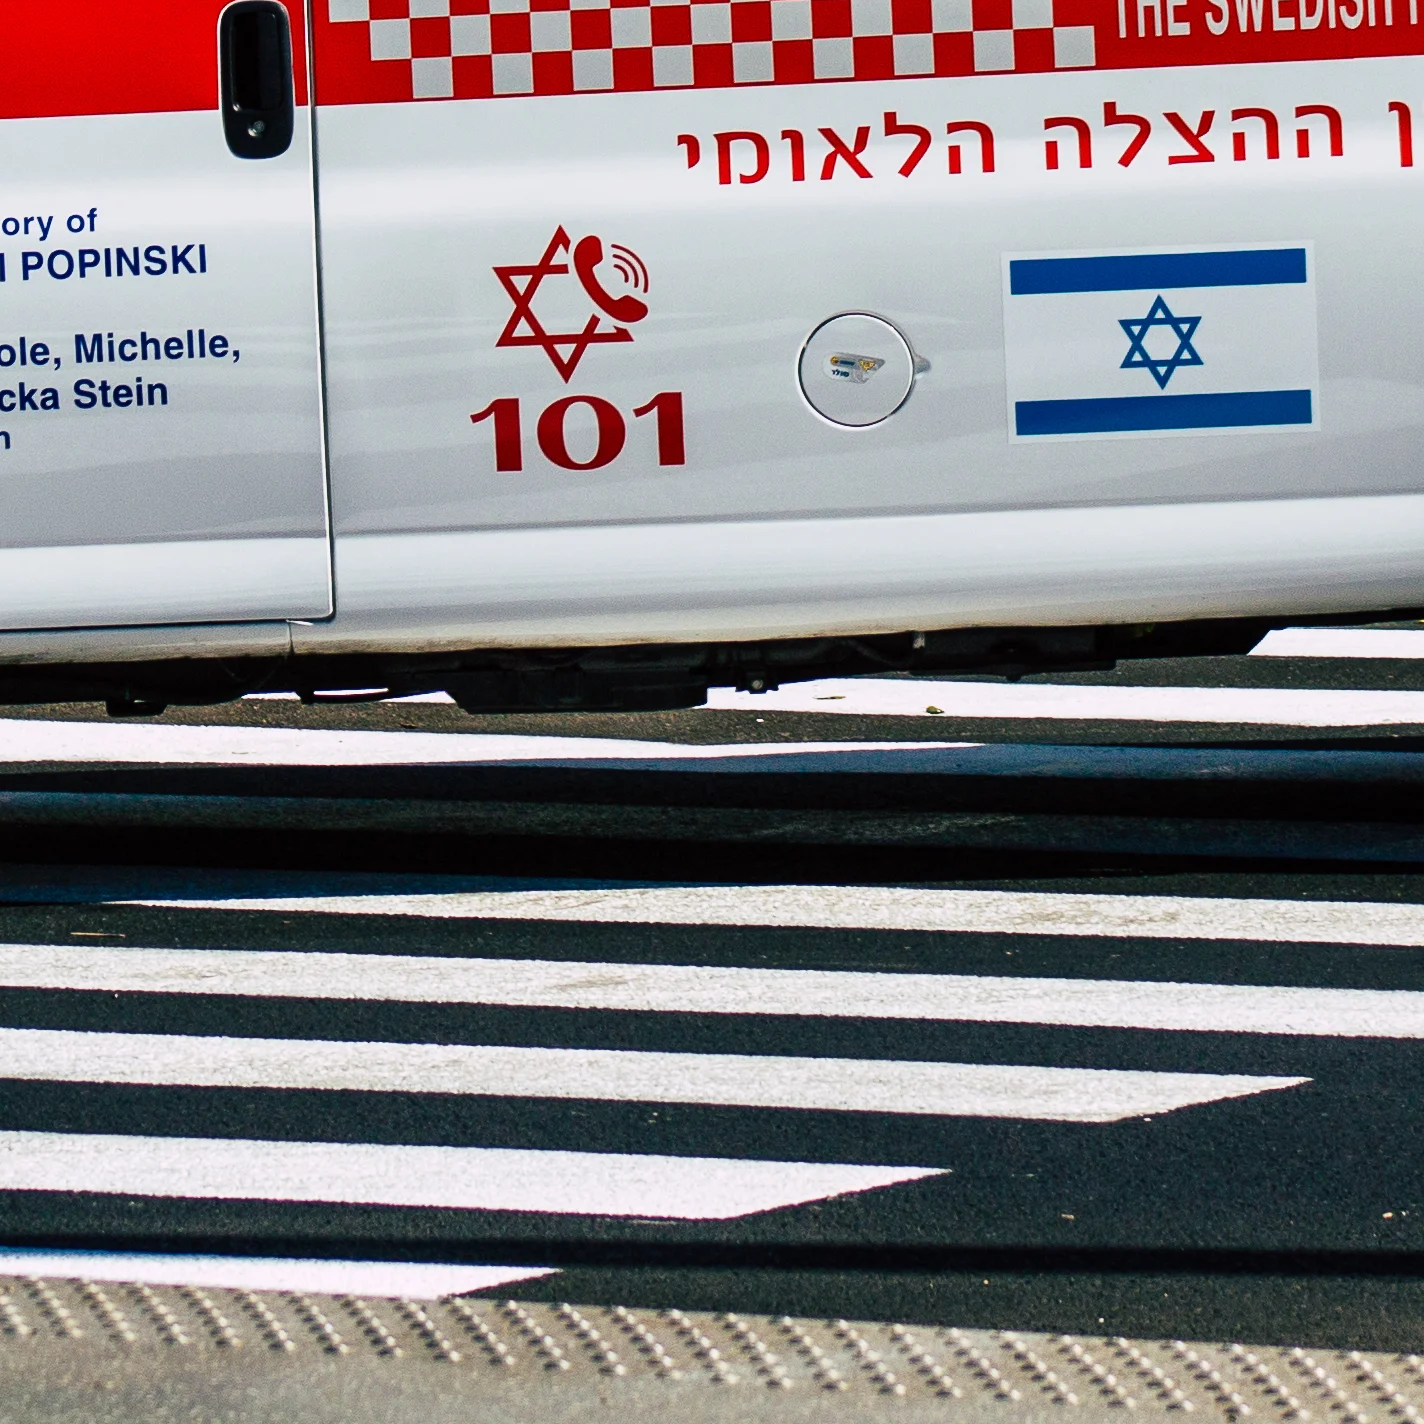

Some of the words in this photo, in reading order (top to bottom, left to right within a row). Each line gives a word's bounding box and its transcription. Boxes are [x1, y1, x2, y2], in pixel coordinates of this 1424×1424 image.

[677, 111, 995, 185] הלאומי
[1043, 101, 1344, 170] ההצלה
[66, 207, 98, 233] of
[21, 243, 207, 281] POPINSKI
[74, 328, 240, 364] Michelle,
[73, 376, 168, 410] Stein
[469, 391, 686, 472] 101
